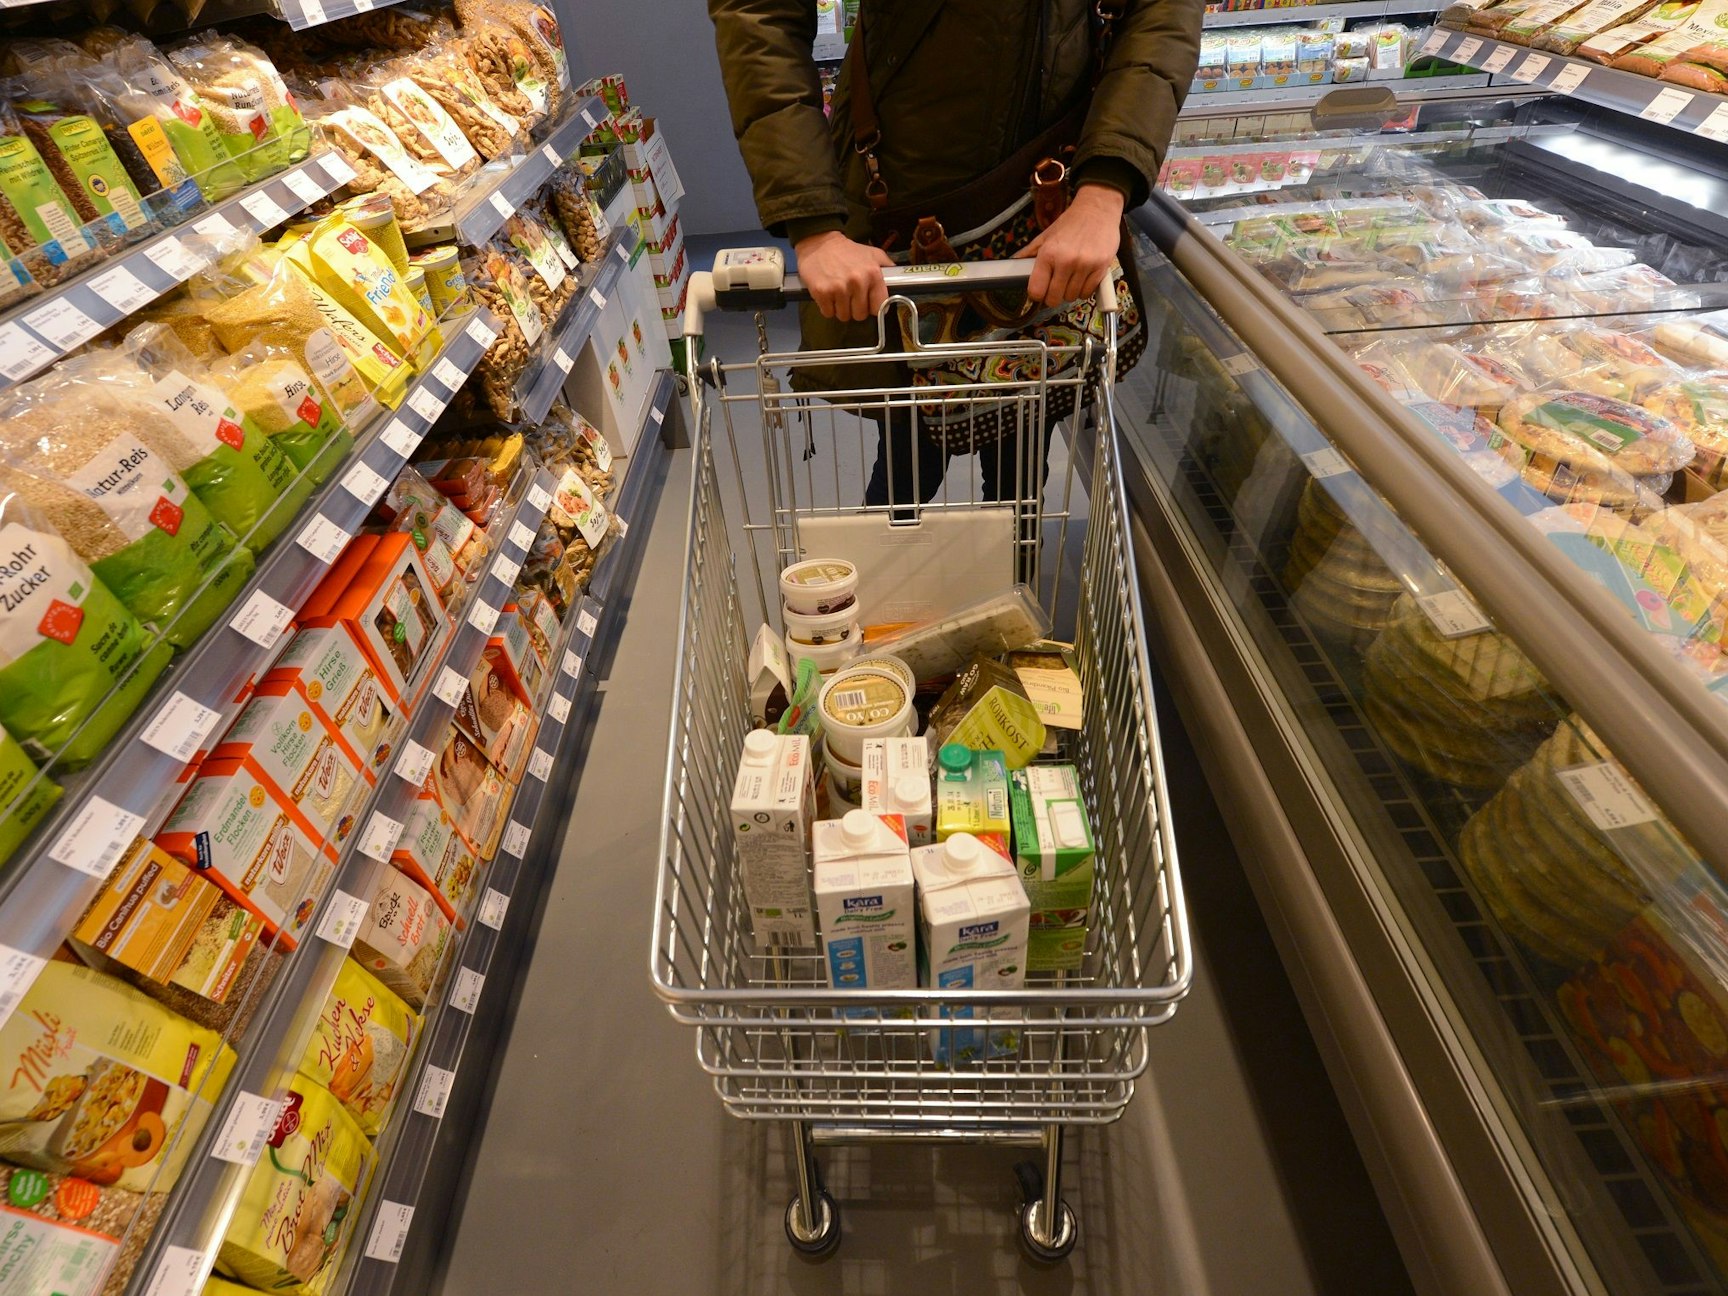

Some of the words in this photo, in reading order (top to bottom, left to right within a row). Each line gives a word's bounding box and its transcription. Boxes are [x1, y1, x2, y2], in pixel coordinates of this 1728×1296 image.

[0, 565, 52, 612] Zucker
[319, 650, 341, 680] Hirse
[988, 696, 1030, 750] ROHKOST
[213, 793, 248, 844] Erdmandel
[226, 808, 252, 846] Flocken
[96, 932, 114, 950] Bio
[108, 891, 140, 931] Canihua
[135, 863, 160, 895] puffed
[10, 1008, 61, 1093] Müsli
[318, 998, 346, 1072] Kuchen
[345, 996, 375, 1056] Kekse
